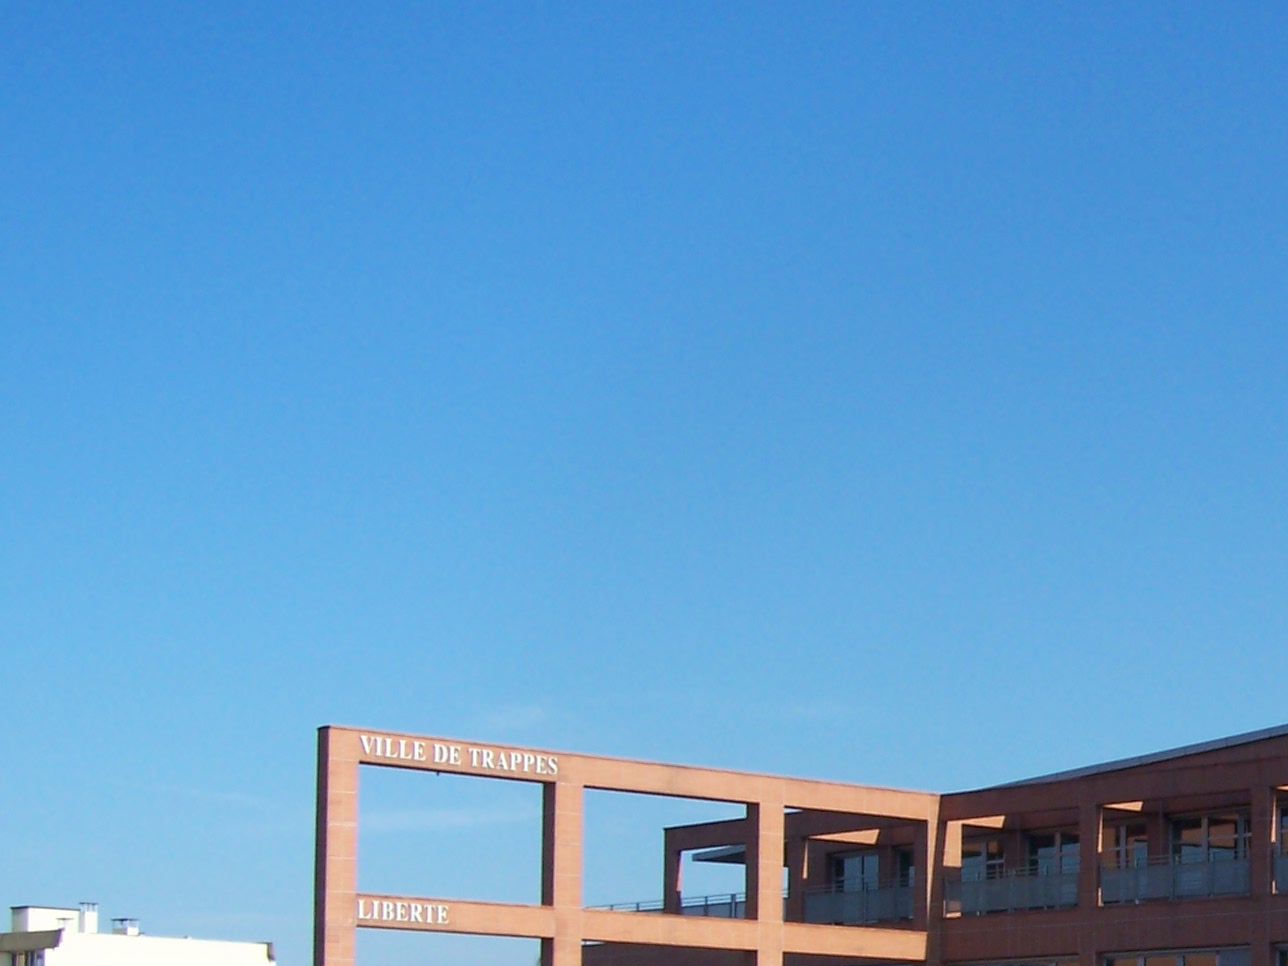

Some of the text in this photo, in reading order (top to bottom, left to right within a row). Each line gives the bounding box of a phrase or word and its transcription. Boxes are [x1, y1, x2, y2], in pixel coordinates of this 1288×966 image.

[360, 734, 560, 776] VILLE DE TRAPPES
[357, 899, 450, 925] LIBERTE
